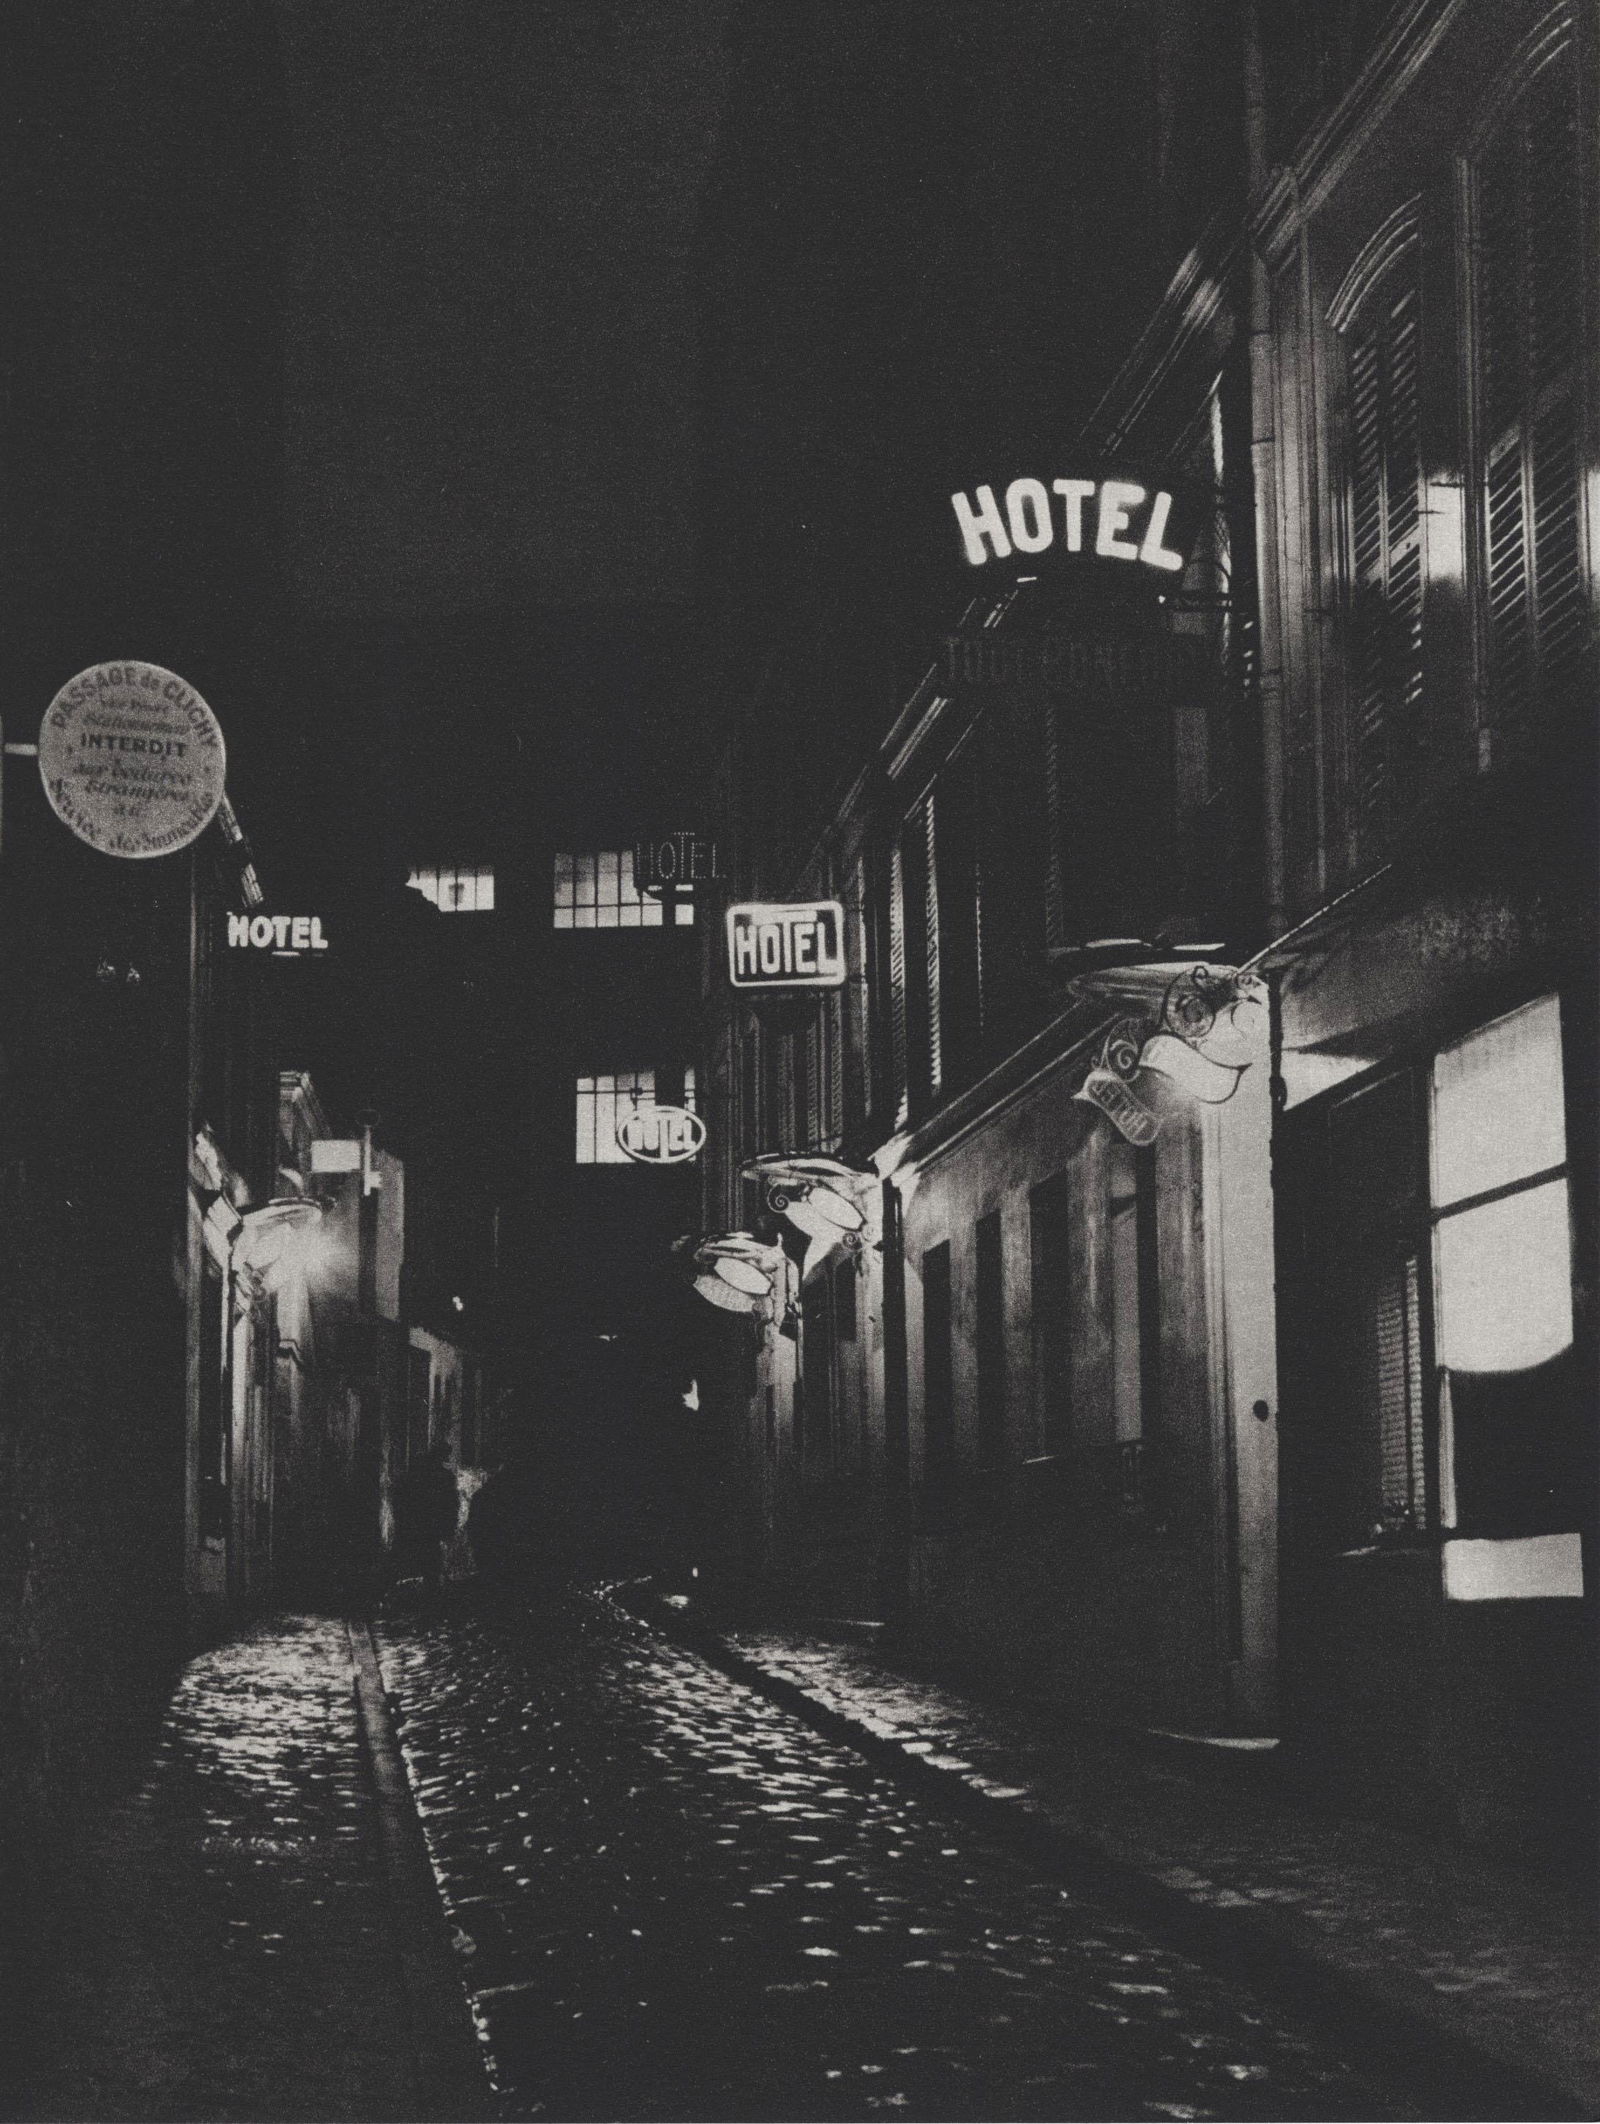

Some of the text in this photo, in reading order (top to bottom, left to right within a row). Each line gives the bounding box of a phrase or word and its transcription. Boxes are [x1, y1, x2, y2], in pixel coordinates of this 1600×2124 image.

[951, 478, 1184, 572] HOTEL
[51, 667, 218, 749] PASSAGE de CLICHY
[81, 733, 187, 758] INTERDIT
[635, 830, 728, 880] HOTEL
[227, 911, 329, 950] HOTEL
[735, 909, 840, 975] HOTEL
